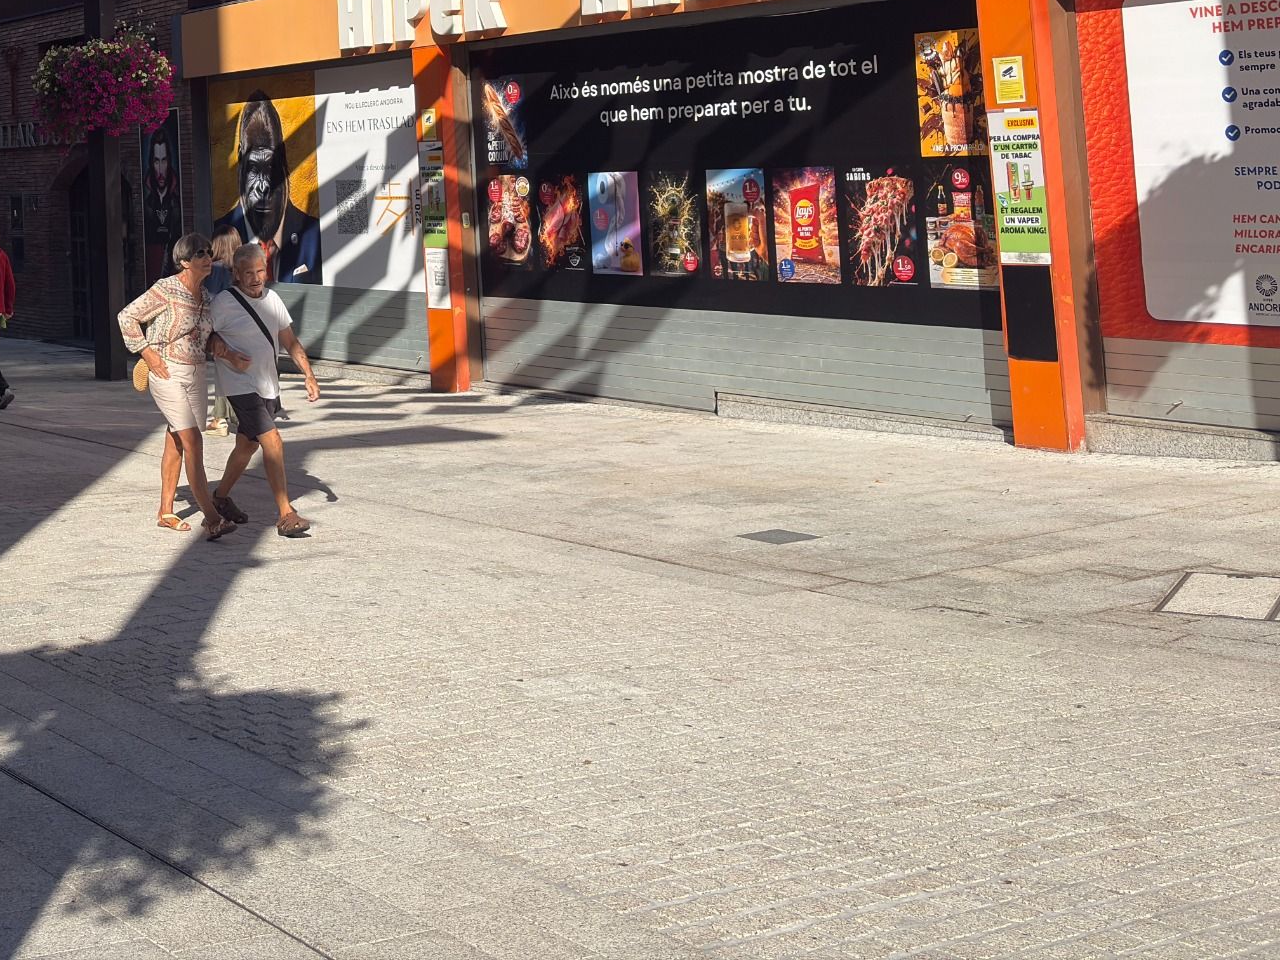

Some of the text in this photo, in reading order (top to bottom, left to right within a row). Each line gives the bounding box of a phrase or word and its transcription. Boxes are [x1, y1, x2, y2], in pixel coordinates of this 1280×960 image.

[1189, 0, 1280, 18] VINE A DESC
[1212, 21, 1243, 33] HEM
[1239, 50, 1276, 59] Els teus
[1240, 63, 1276, 72] sempre
[550, 55, 878, 100] Això és només una petita mostra de tot el
[1241, 88, 1260, 96] Una
[600, 95, 812, 126] que hem preparat per a tu.
[327, 121, 343, 133] ENS
[346, 119, 365, 132] HEM
[1007, 118, 1034, 128] EXCLUSIVA
[1012, 134, 1040, 142] COMPRA
[1235, 166, 1277, 176] SEMPRE
[1233, 214, 1256, 223] HEM
